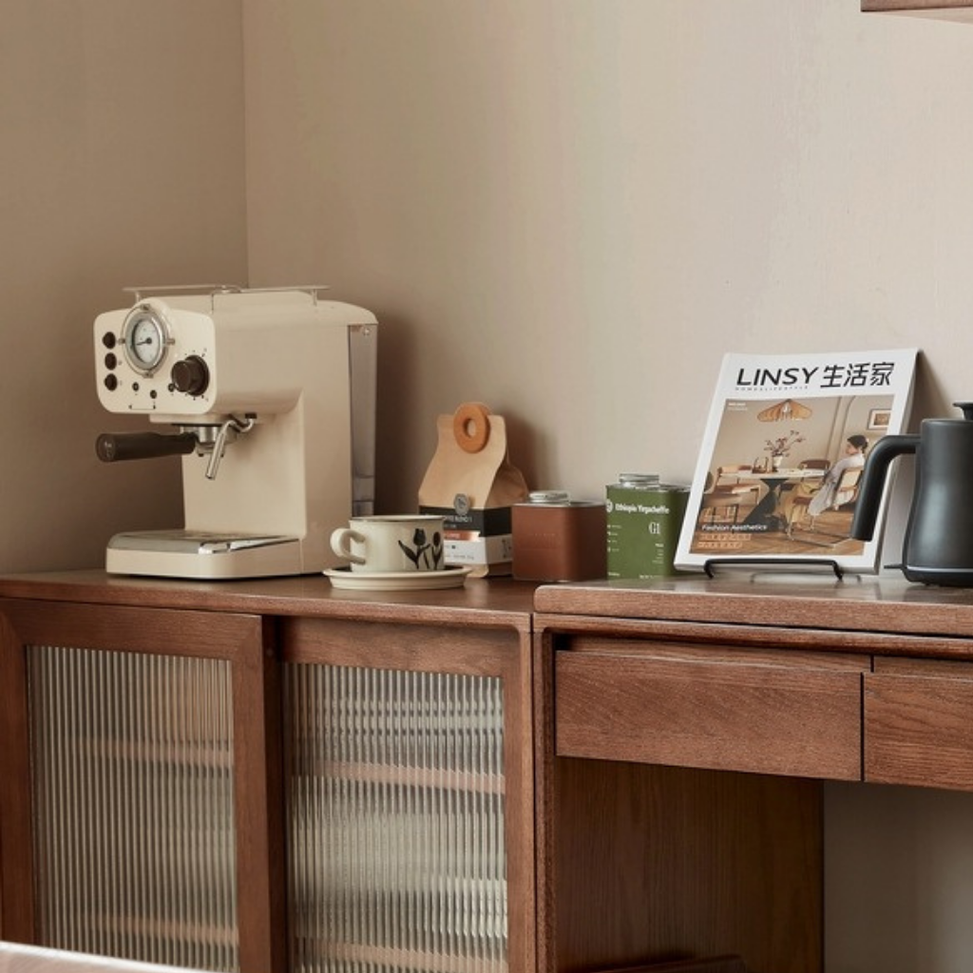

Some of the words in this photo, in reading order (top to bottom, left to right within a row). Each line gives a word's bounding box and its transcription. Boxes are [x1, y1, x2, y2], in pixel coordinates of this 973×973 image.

[737, 367, 819, 386] LINSY
[820, 361, 895, 388] 生活家
